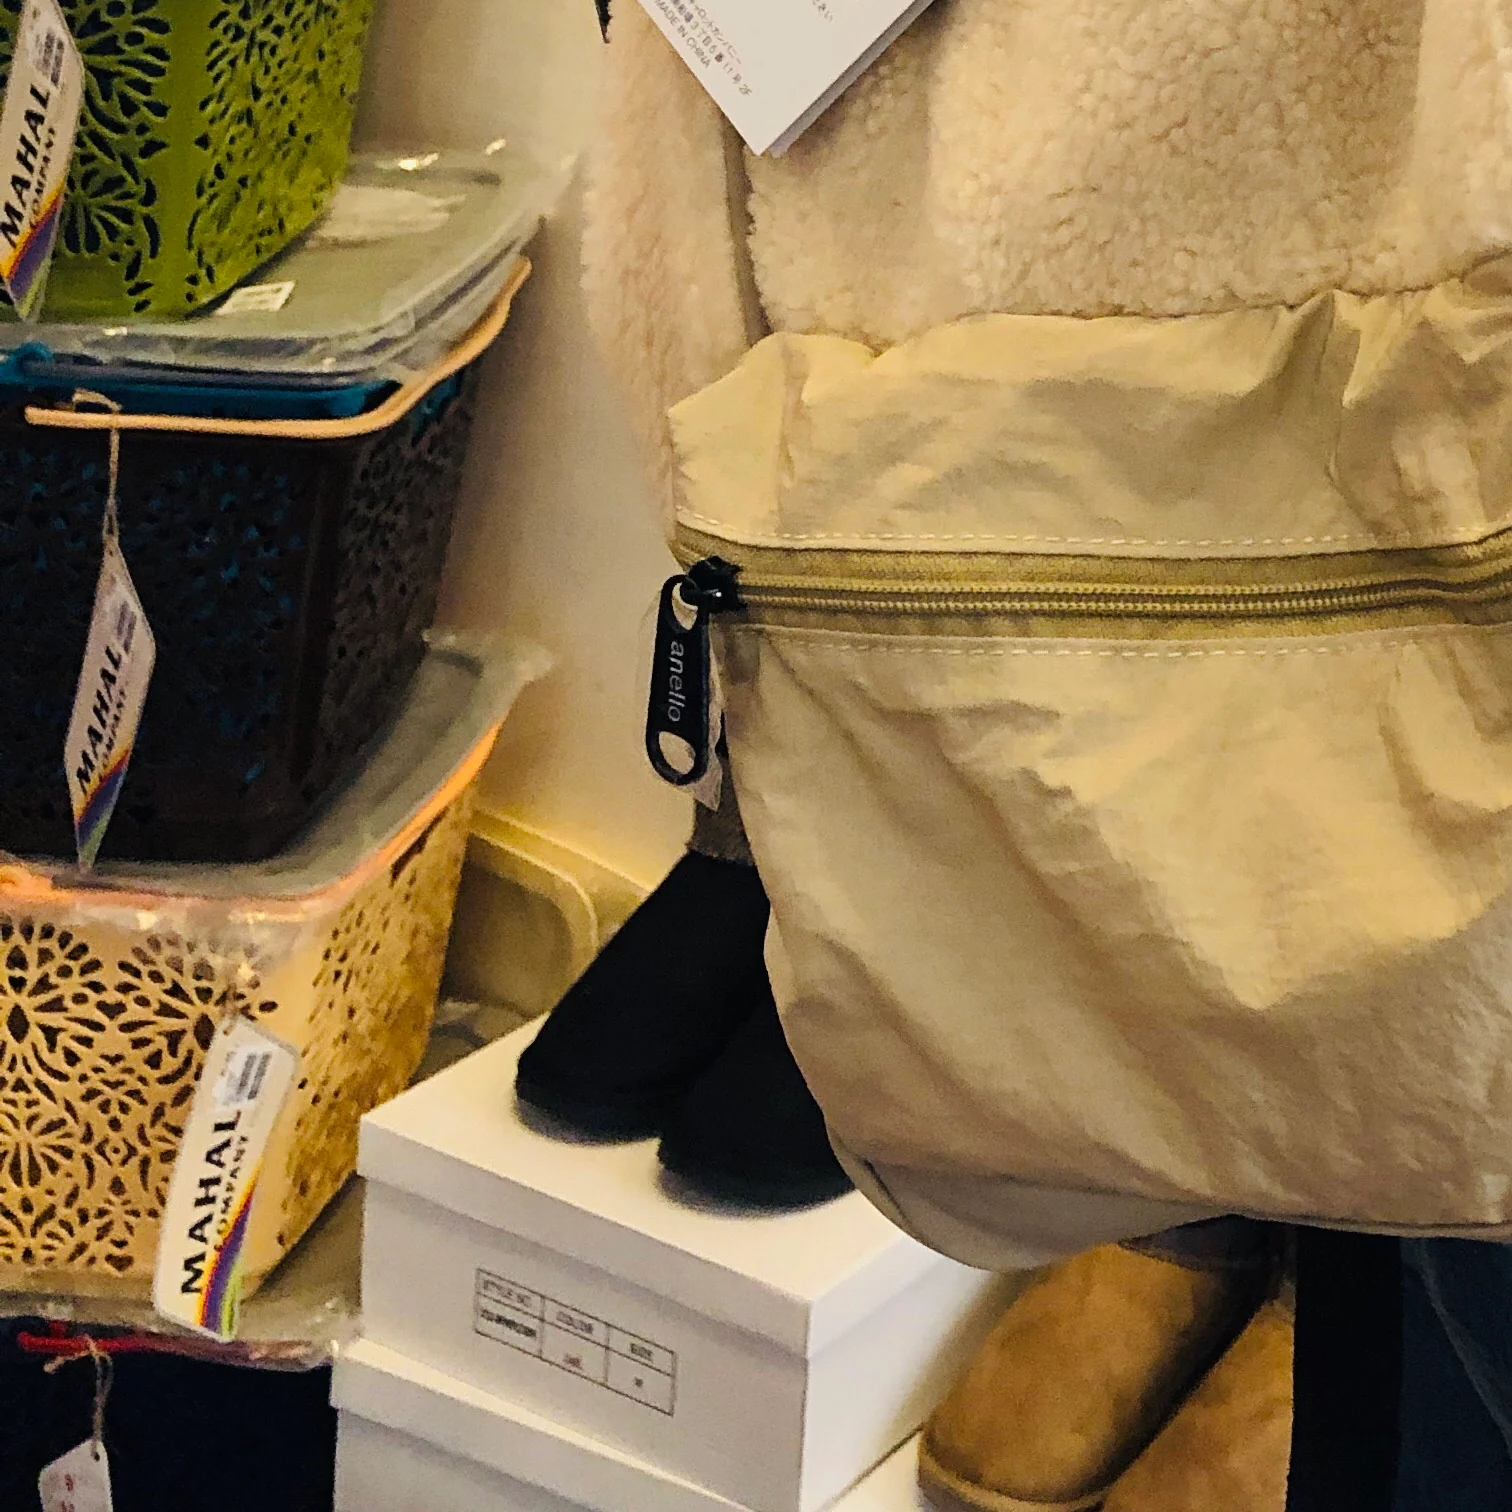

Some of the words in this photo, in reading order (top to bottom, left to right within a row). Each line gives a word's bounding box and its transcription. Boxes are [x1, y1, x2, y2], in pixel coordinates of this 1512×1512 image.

[687, 36, 711, 68] CHINA
[0, 83, 51, 249] MAHAL
[76, 645, 122, 795] MAHAL
[667, 640, 689, 723] anello
[180, 1109, 242, 1294] MAHAL
